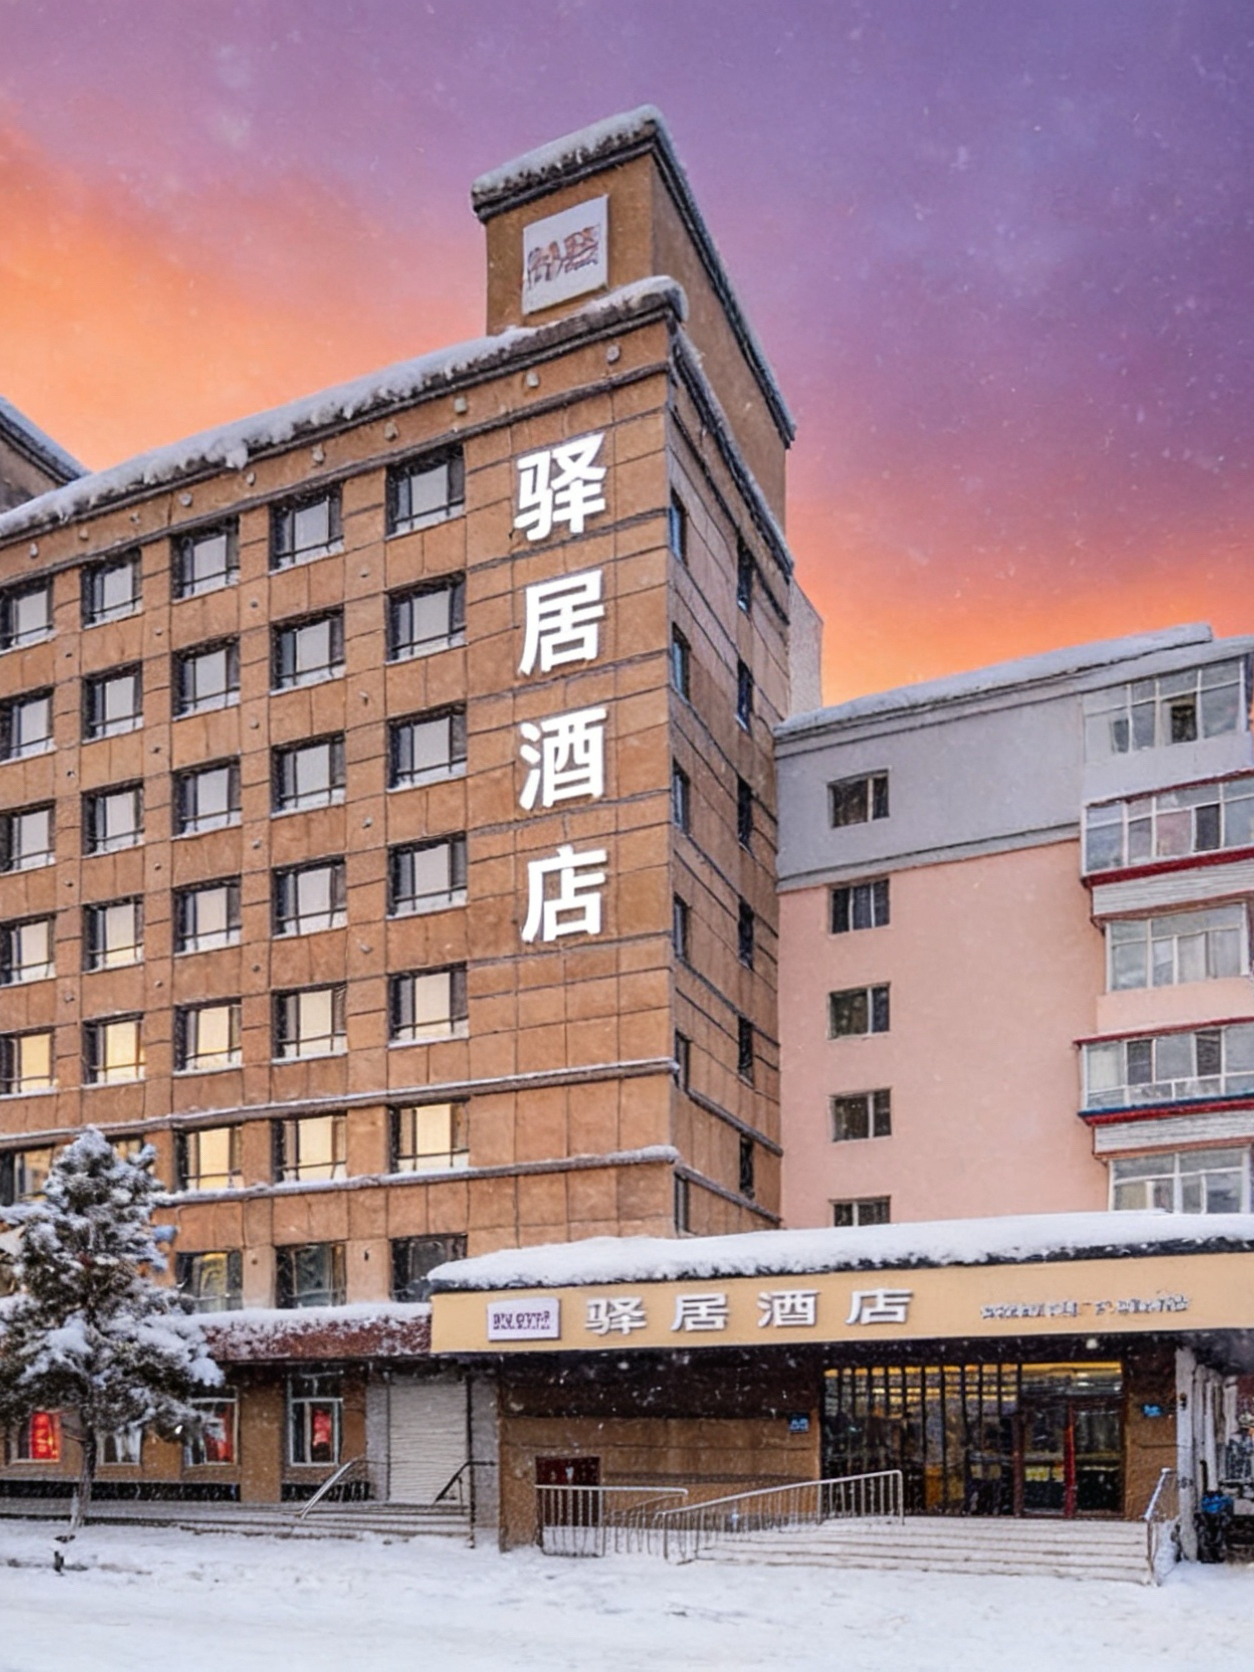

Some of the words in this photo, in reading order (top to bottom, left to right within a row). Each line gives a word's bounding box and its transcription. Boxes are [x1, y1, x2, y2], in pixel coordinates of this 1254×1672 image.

[514, 432, 606, 943] 驿居酒店
[585, 1288, 912, 1335] 驿居酒店
